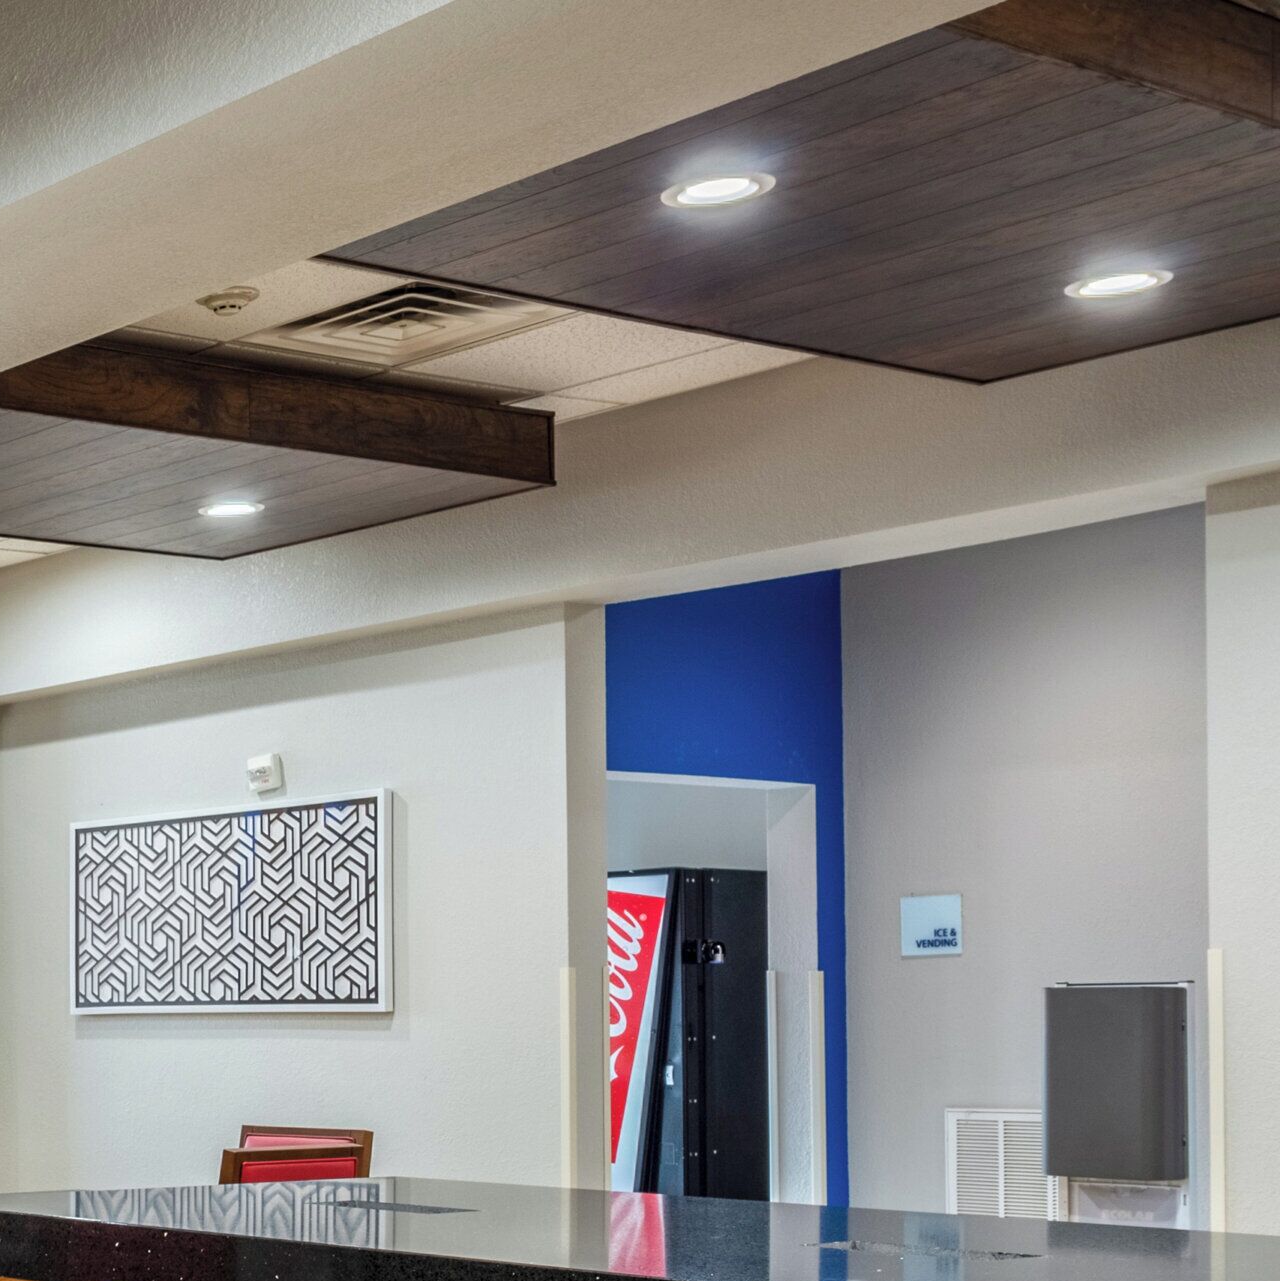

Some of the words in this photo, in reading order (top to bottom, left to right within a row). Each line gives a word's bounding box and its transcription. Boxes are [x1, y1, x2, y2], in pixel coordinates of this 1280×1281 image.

[933, 928, 948, 937] ICE
[949, 927, 957, 937] &
[915, 938, 958, 948] VENDING
